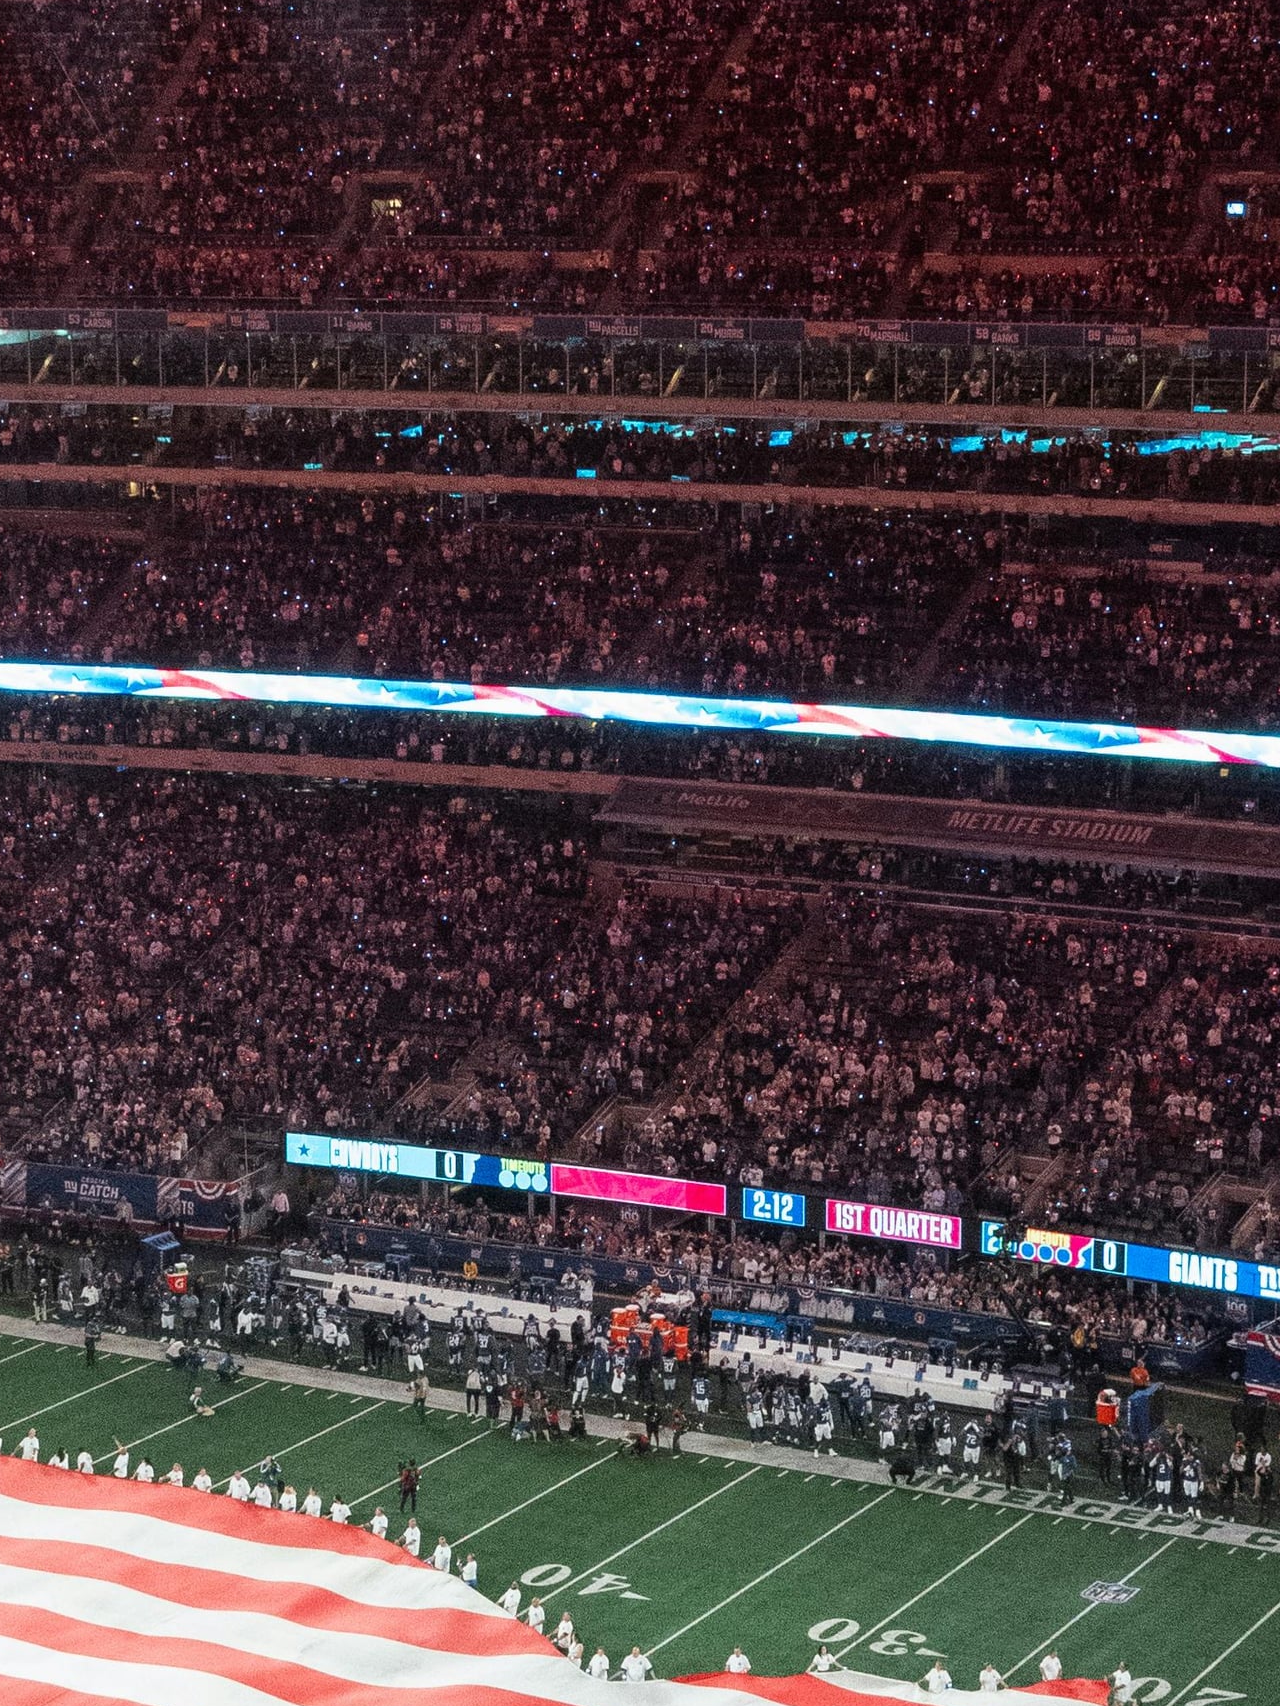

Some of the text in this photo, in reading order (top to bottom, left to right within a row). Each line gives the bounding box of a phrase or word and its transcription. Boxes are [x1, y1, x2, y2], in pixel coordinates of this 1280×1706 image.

[83, 318, 113, 329] CARSON
[602, 325, 639, 337] PARCELLS
[858, 325, 911, 343] 70 MARSHALL
[678, 792, 750, 810] MetLife
[948, 810, 1154, 845] METLIFE STADIUM
[330, 1139, 457, 1178] COWBOYS 0
[501, 1157, 546, 1175] TIMEOUTS
[80, 1183, 120, 1199] CATCH
[753, 1190, 794, 1222] 2:12
[835, 1202, 866, 1232] 1ST
[870, 1207, 953, 1244] QUARTER
[1026, 1227, 1071, 1248] IMEOUTS
[1103, 1241, 1117, 1271] 0
[1169, 1252, 1238, 1292] GIANTS
[696, 1384, 706, 1395] 15
[520, 1563, 632, 1599] 40
[807, 1617, 926, 1657] 30
